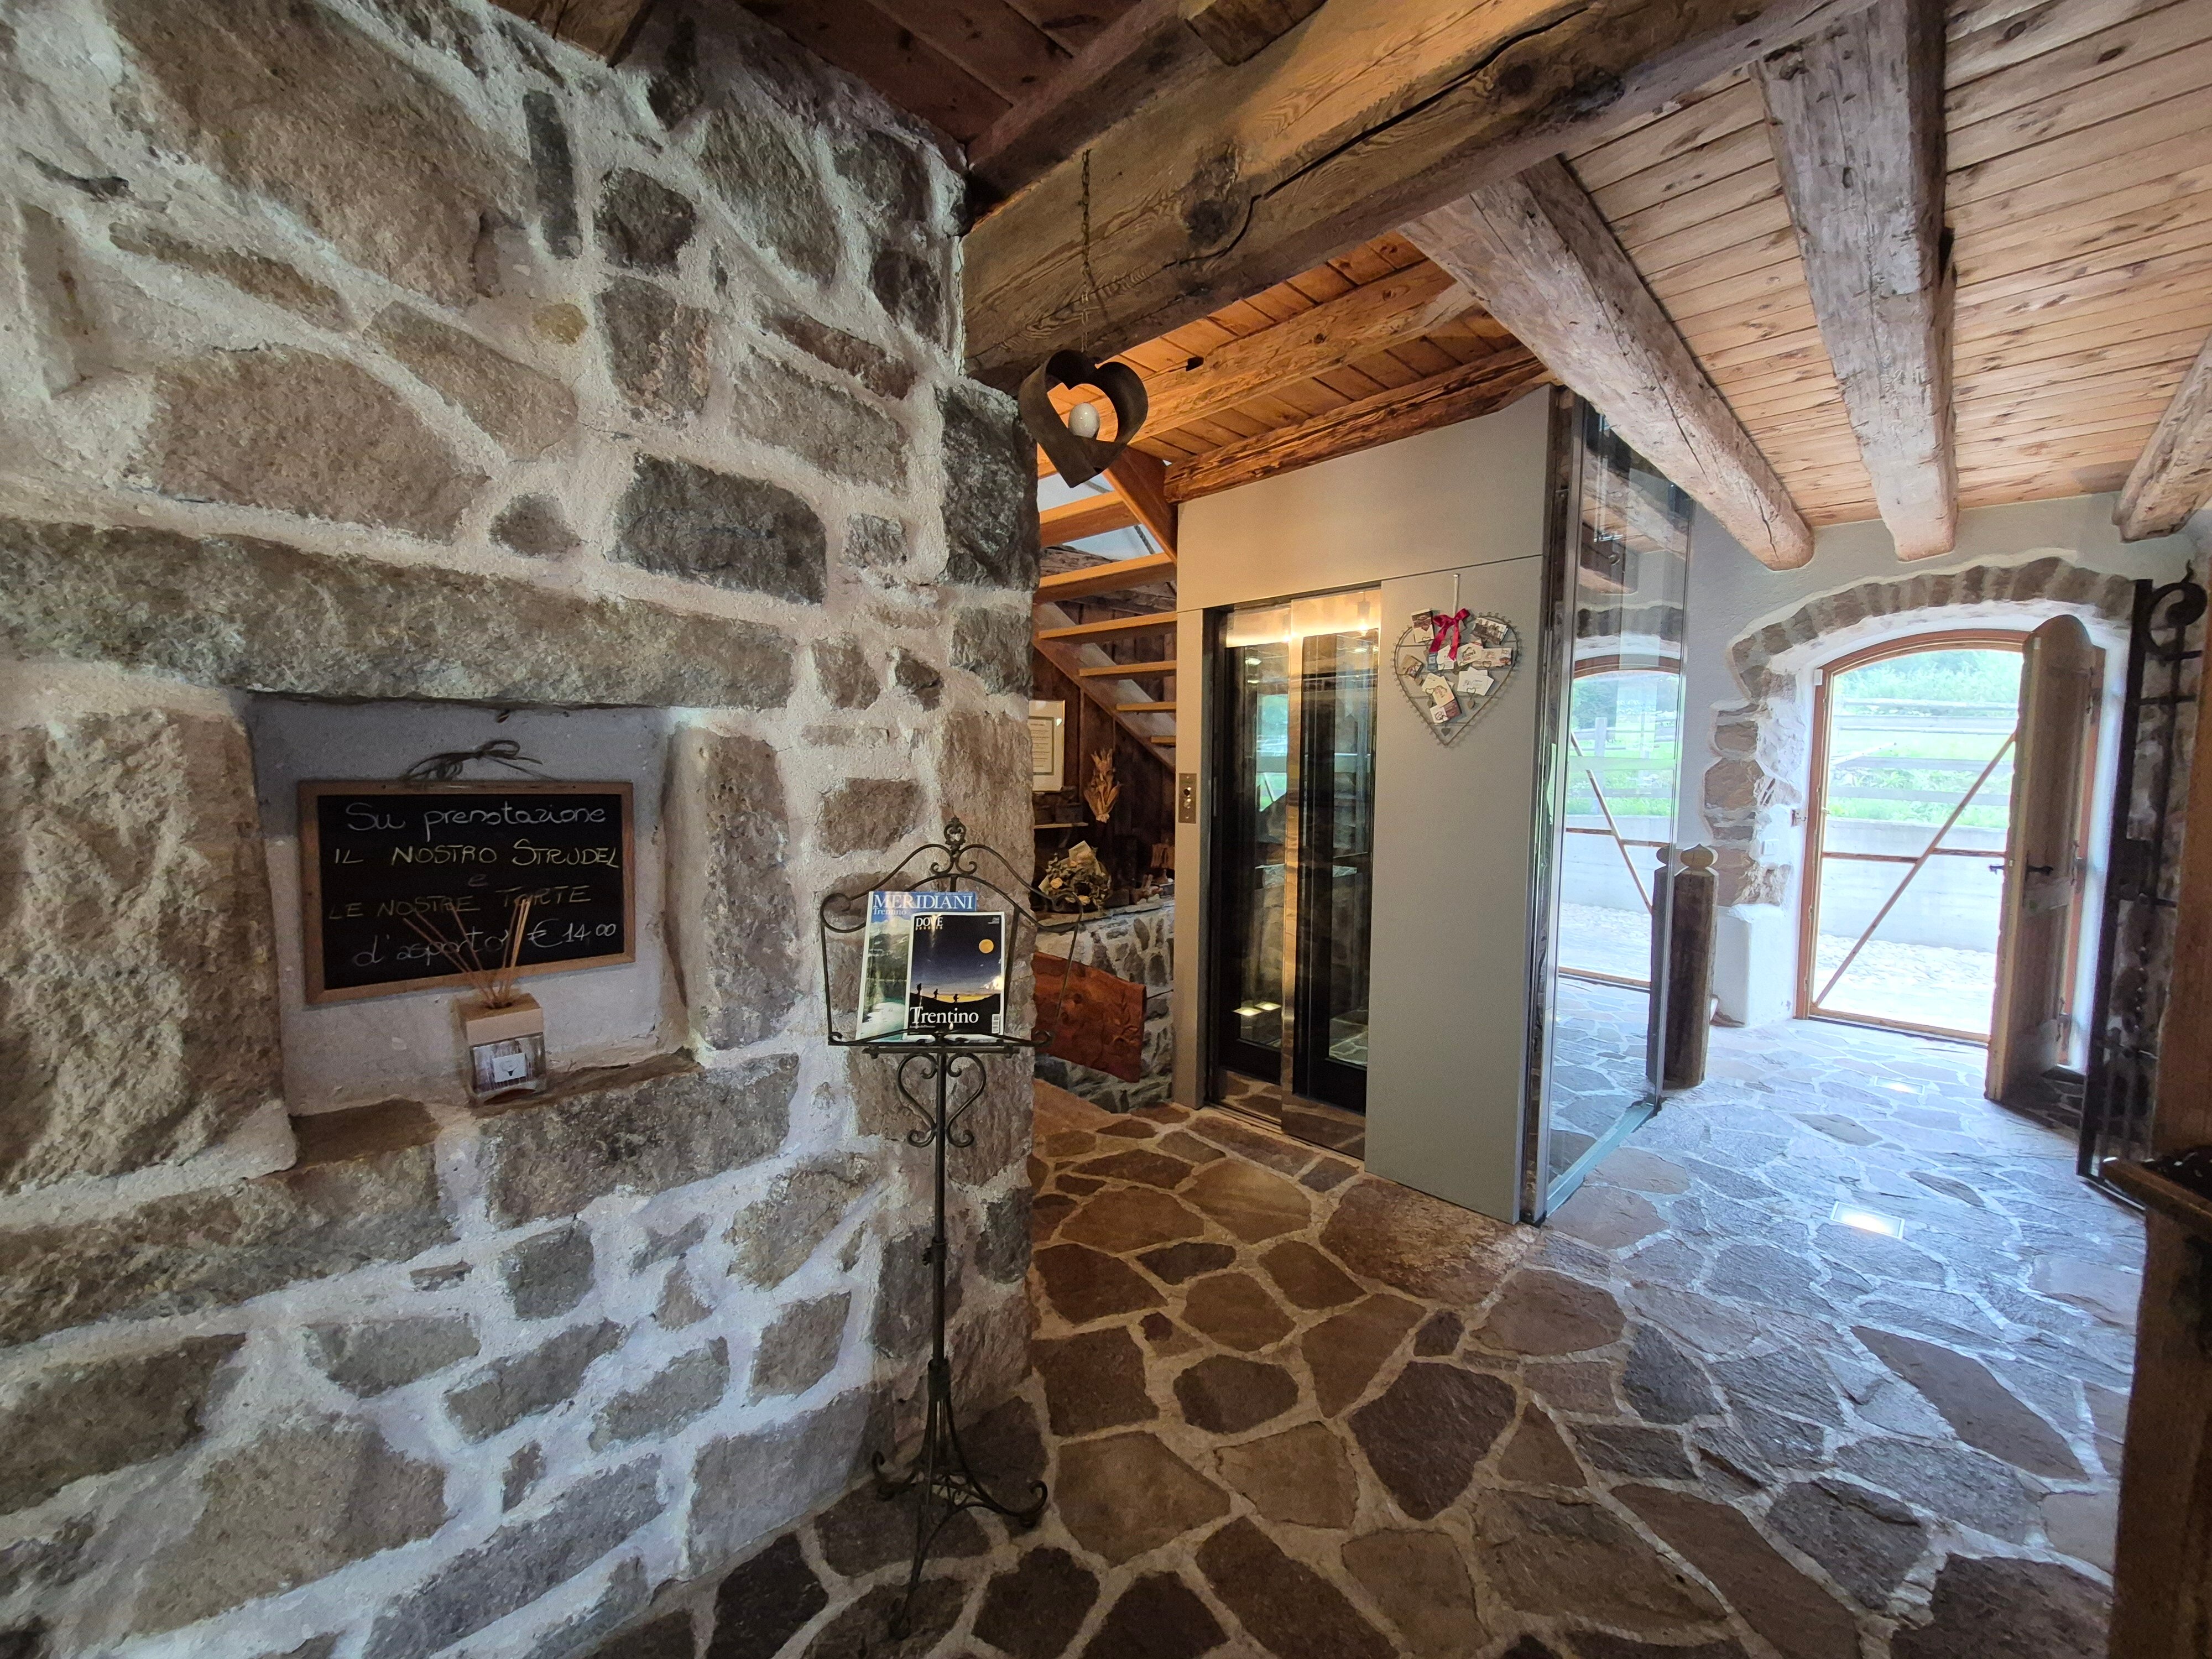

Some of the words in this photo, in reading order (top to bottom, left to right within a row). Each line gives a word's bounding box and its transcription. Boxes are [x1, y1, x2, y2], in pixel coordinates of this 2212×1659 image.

[346, 802, 406, 831] Su
[424, 801, 606, 842] prenotazione
[335, 848, 364, 864] IL
[391, 844, 497, 865] NOSTRO
[512, 838, 619, 868] STRUDEL
[329, 902, 363, 919] LE
[378, 895, 481, 917] NOSTRE
[873, 894, 974, 910] MERIDIANI
[916, 917, 944, 927] DOVE
[910, 1006, 979, 1024] Trentino
